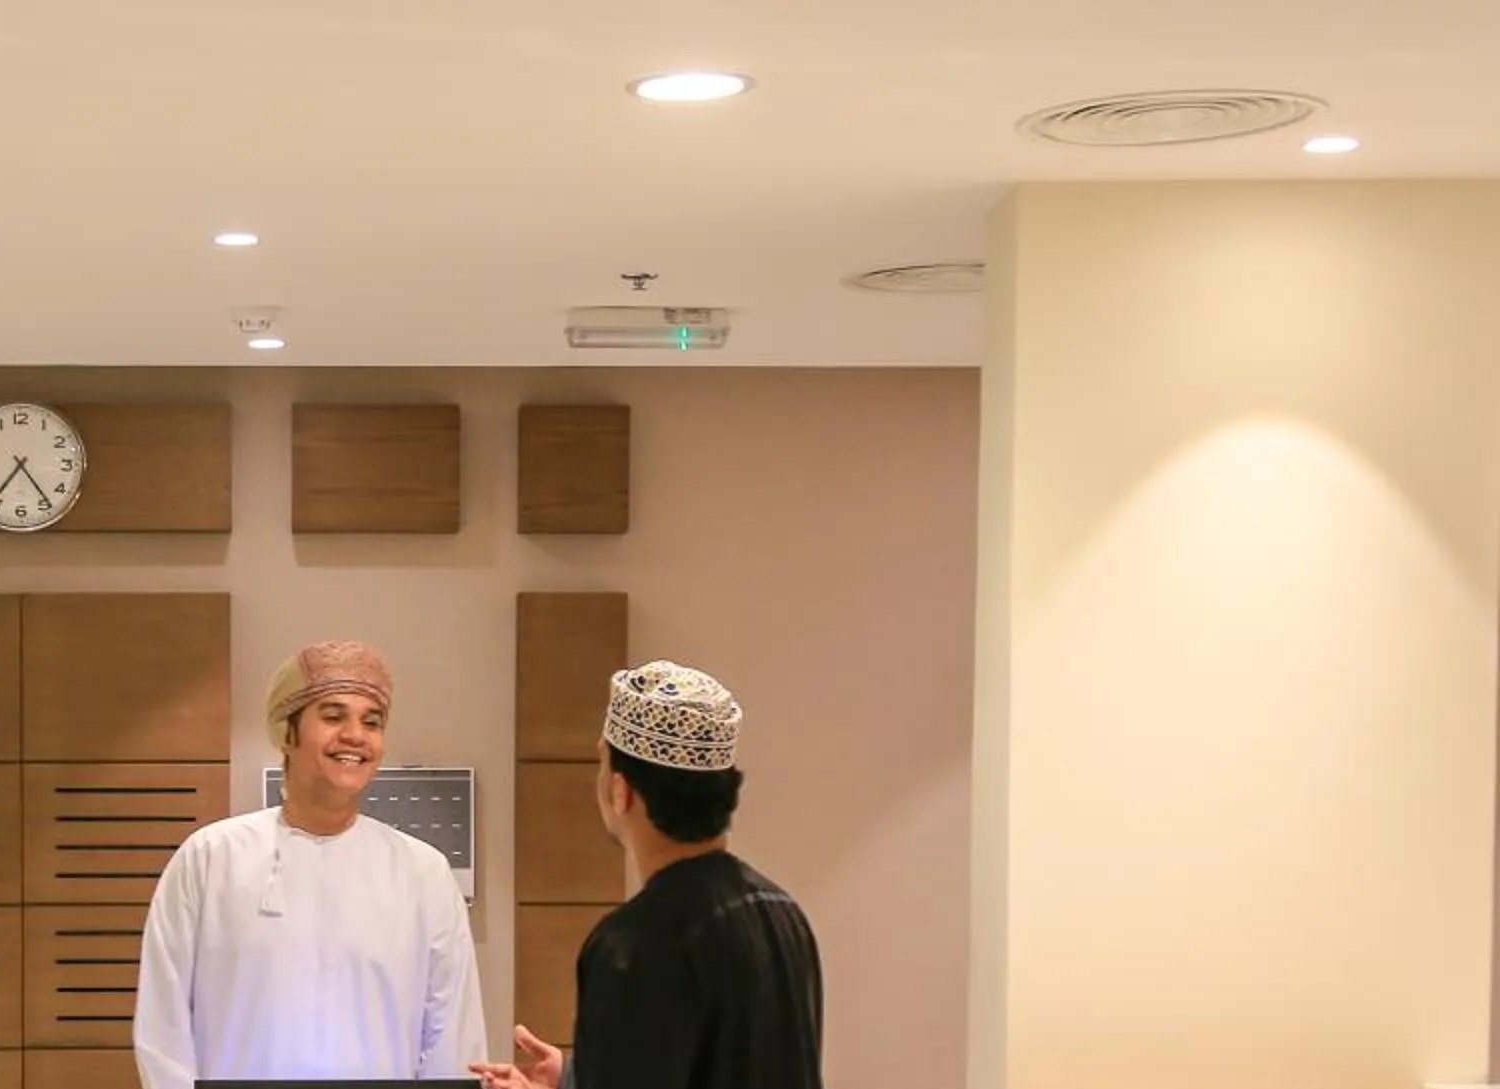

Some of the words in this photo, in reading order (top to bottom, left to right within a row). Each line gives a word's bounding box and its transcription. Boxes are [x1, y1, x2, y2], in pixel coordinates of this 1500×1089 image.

[13, 412, 29, 425] 12
[40, 418, 46, 431] 1
[53, 435, 66, 449] 2
[60, 459, 73, 472] 3
[54, 482, 67, 495] 4
[15, 505, 27, 517] 6
[38, 499, 51, 511] 5
